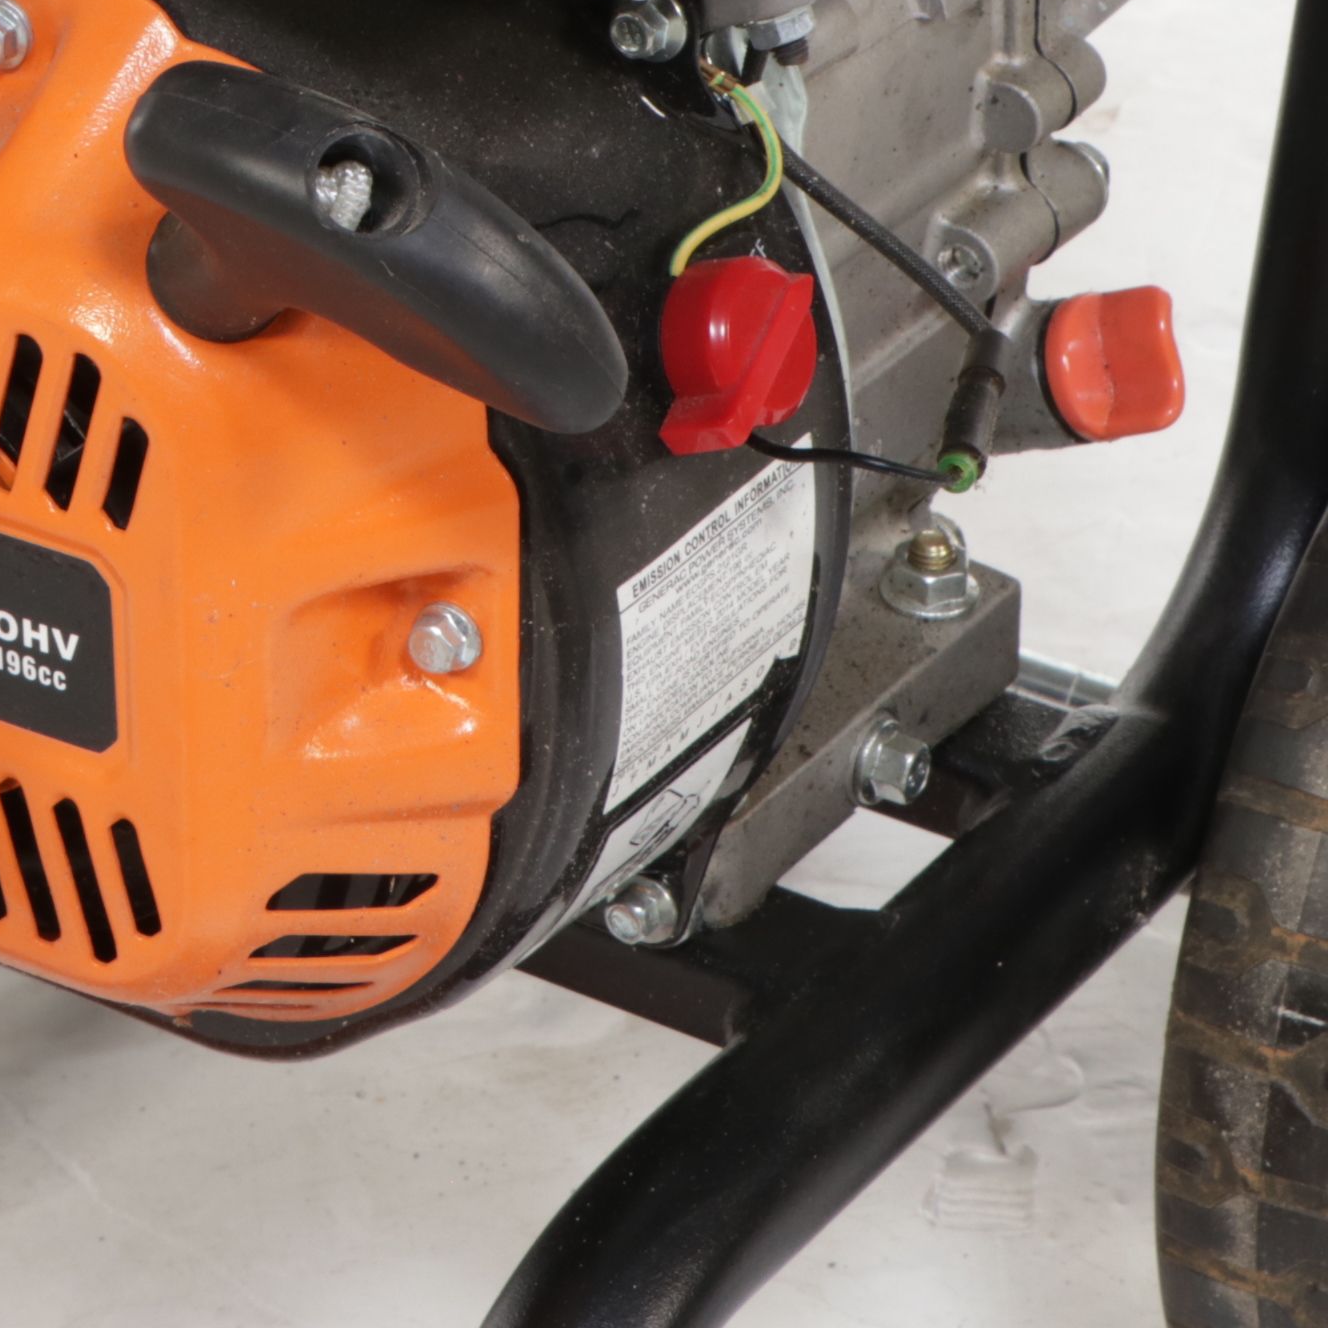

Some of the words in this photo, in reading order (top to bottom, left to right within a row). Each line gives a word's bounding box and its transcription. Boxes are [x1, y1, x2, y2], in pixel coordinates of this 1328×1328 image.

[632, 550, 681, 598] EMISSION
[684, 508, 731, 555] CONTROL
[638, 566, 688, 613] GENERAC
[688, 534, 728, 573] POWER
